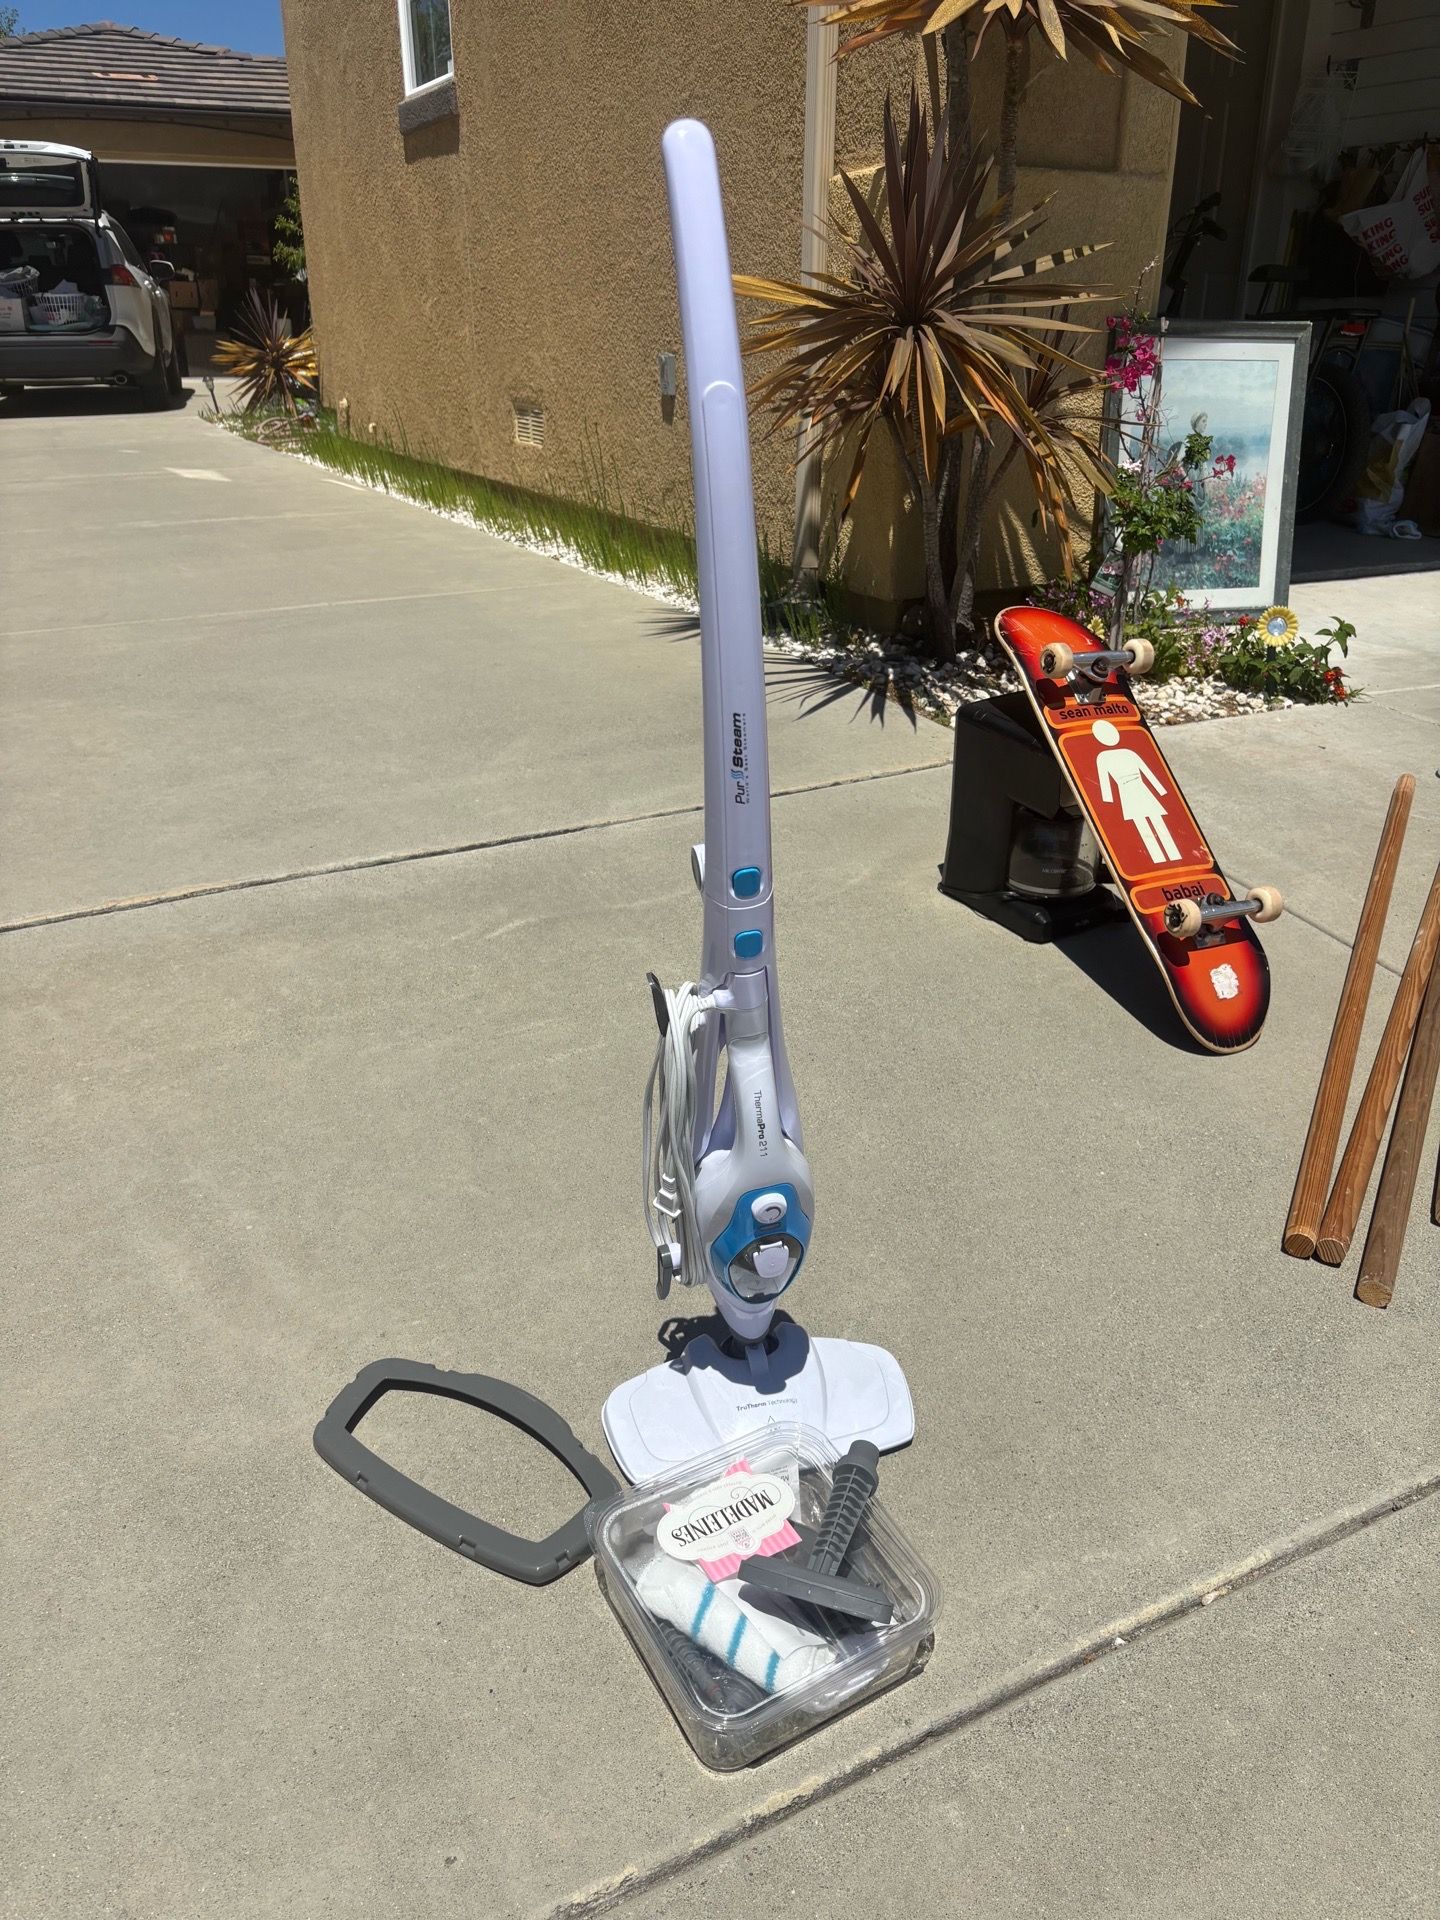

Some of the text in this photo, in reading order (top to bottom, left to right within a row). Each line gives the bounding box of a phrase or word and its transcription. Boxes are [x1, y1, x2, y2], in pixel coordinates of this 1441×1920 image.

[1361, 217, 1393, 239] KING
[1060, 703, 1129, 720] sean malto
[732, 712, 745, 805] Pur Steam
[754, 1090, 768, 1157] ThermaPro 211
[736, 1402, 767, 1411] TruTherm
[671, 1490, 775, 1547] MADELEINES
